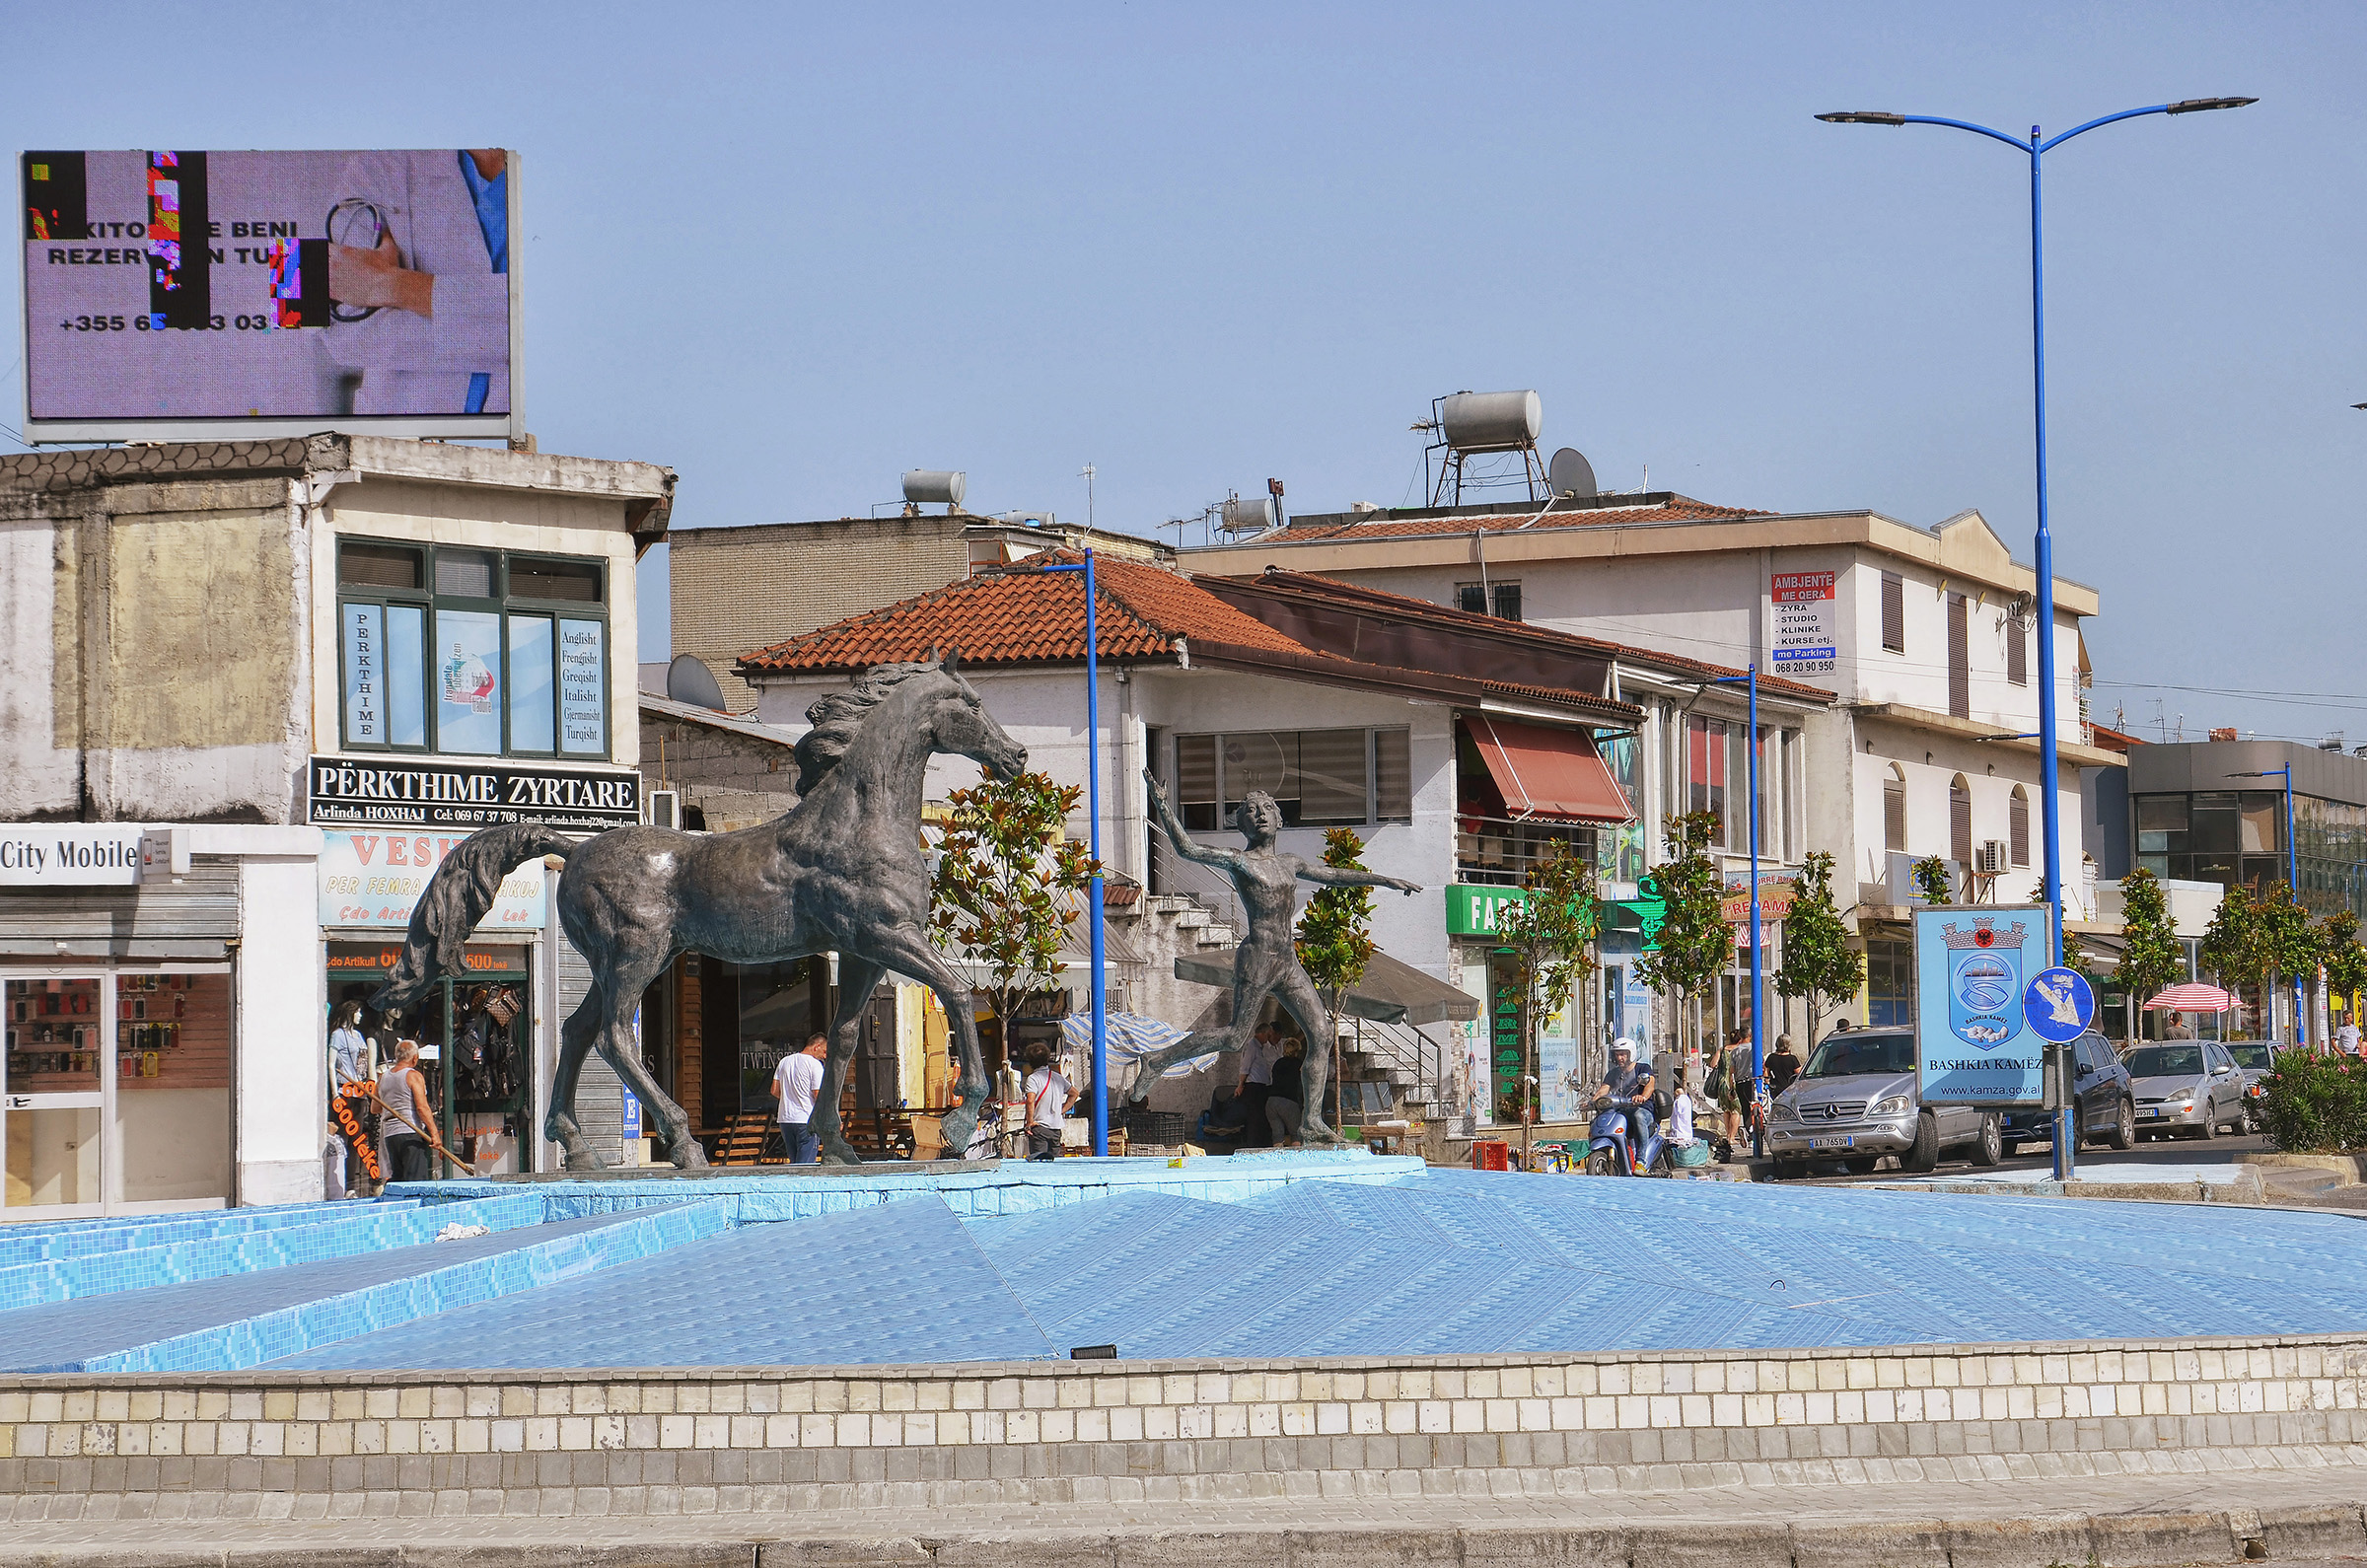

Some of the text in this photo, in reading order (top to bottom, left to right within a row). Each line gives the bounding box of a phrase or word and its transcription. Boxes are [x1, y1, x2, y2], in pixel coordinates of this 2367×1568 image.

[231, 222, 297, 238] BENI
[60, 315, 125, 331] +355
[1774, 575, 1832, 589] AMBJENTE
[1781, 591, 1826, 601] ME QERA
[1781, 625, 1821, 634] KLINIKE
[562, 631, 597, 646] Anglisht
[1781, 636, 1814, 645] KURSE
[562, 650, 598, 666] Frengjisht
[1795, 648, 1831, 659] Parking
[356, 613, 374, 736] PERKTHIME
[1775, 661, 1834, 674] 068 20 90 950
[444, 665, 453, 701] translate
[562, 669, 597, 684] Greqisht
[564, 688, 597, 703] Italisht
[565, 725, 598, 742] Turqisht
[317, 761, 634, 809] PËRKTHIME ZYRTARE
[314, 804, 361, 819] Arlinda
[365, 806, 425, 820] HOXHAJ
[434, 808, 453, 820] Cel:
[455, 810, 471, 821] 069
[472, 810, 484, 821] 67
[487, 811, 498, 822] 37
[500, 812, 518, 822] 708
[0, 840, 137, 875] City Mobile
[325, 876, 359, 894] PER
[366, 877, 421, 895] FEMRA
[339, 905, 370, 922] Çdo
[501, 908, 530, 922] Lek
[343, 956, 377, 967] Artikull
[1929, 1056, 2044, 1070] BASHKIA KAMËZ
[1940, 1085, 2041, 1097] www.kamza.gov.al
[331, 1097, 360, 1136] 600
